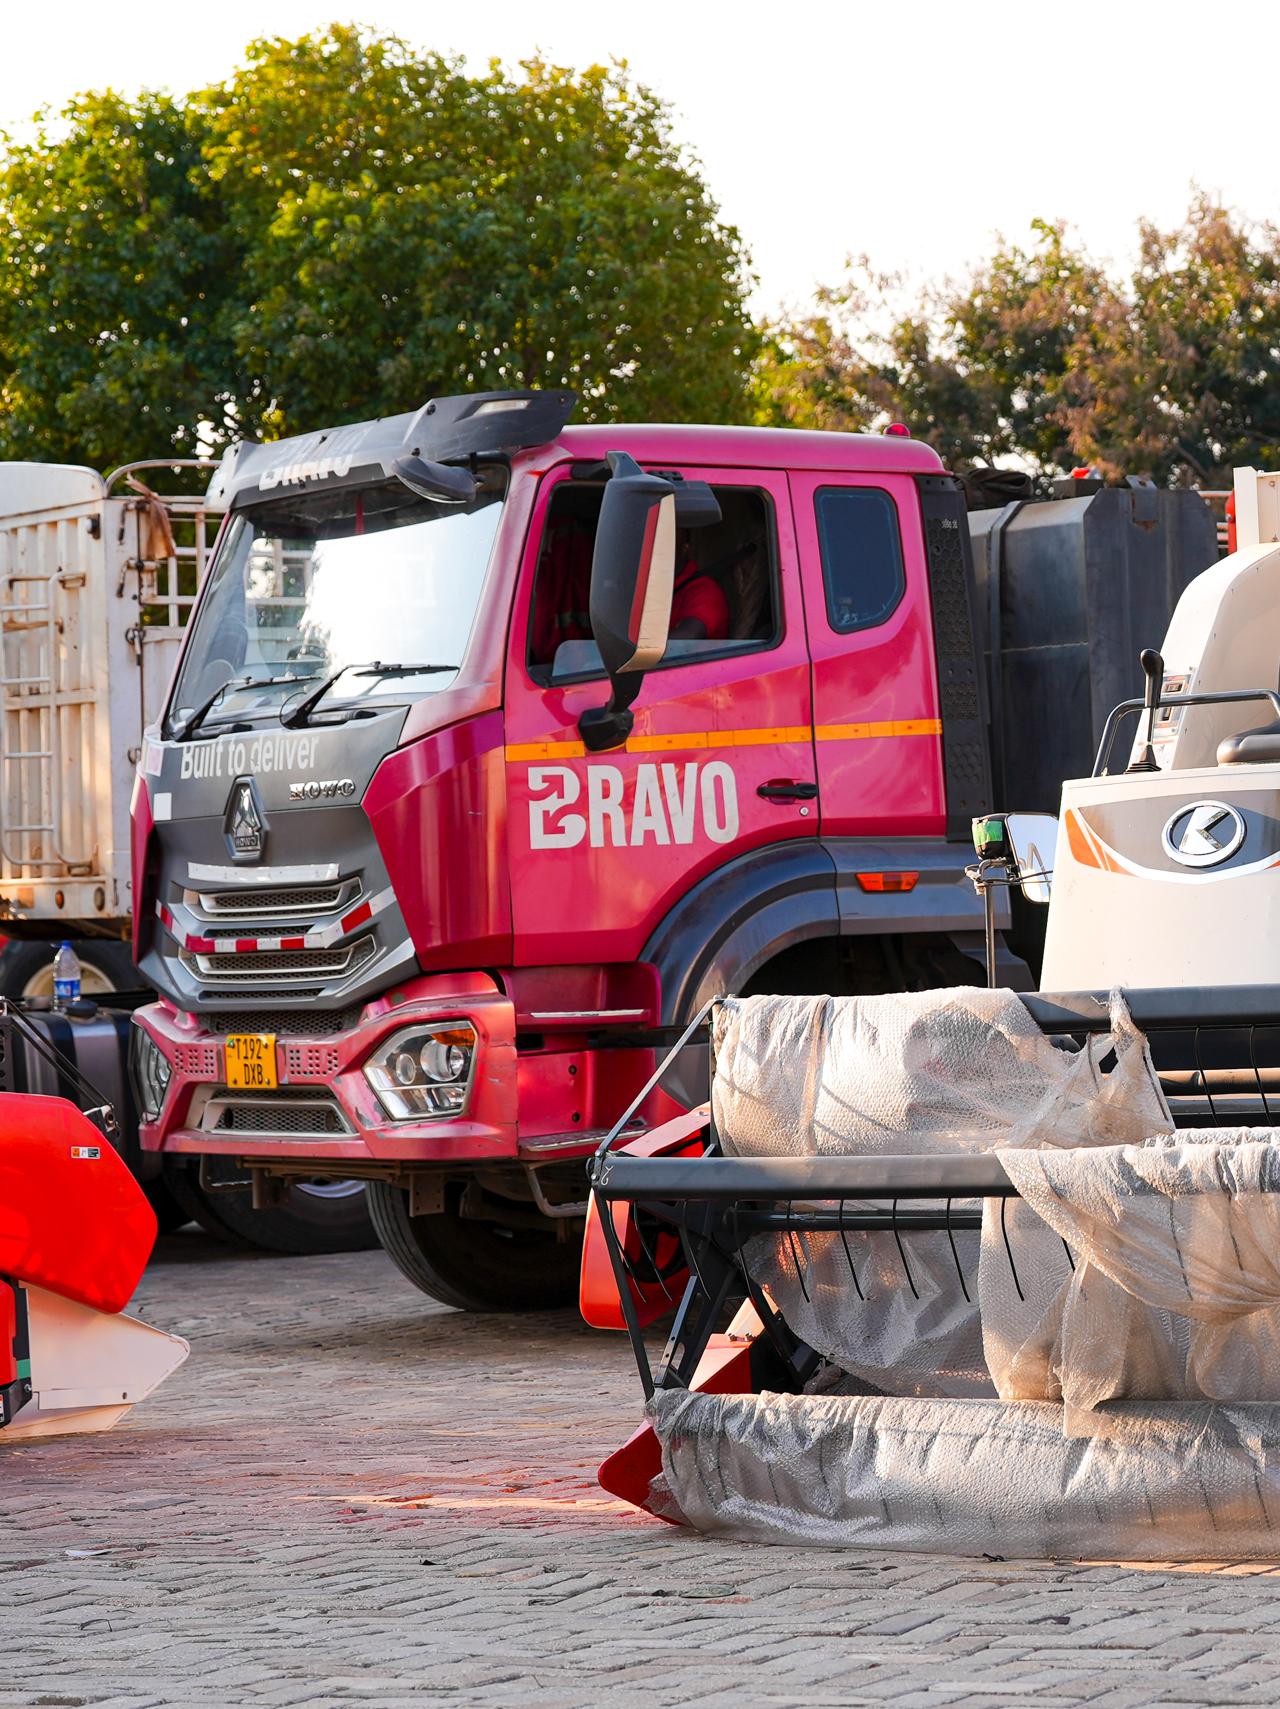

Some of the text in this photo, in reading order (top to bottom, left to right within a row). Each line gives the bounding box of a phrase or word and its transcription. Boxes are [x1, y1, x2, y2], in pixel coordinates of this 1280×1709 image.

[180, 735, 320, 780] Built to deliver
[527, 760, 740, 850] BRAVO
[236, 1038, 262, 1060] T192
[243, 1063, 264, 1085] DXB
